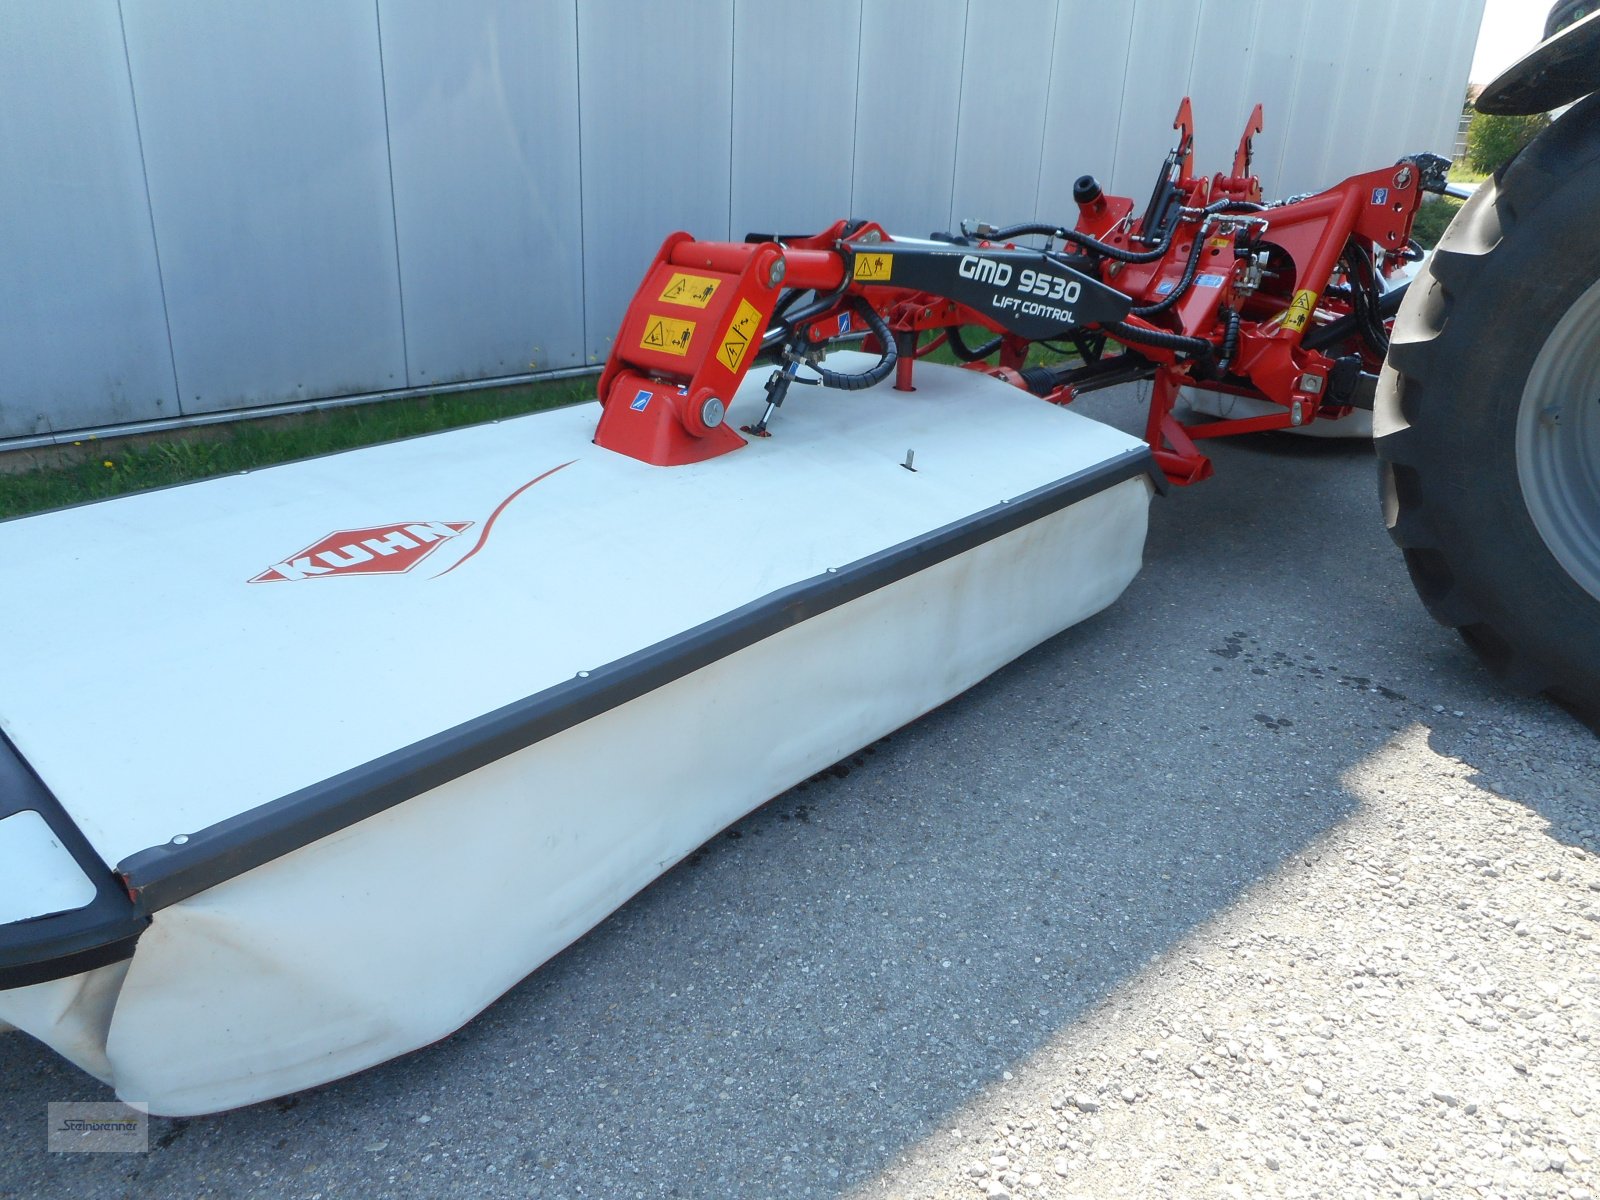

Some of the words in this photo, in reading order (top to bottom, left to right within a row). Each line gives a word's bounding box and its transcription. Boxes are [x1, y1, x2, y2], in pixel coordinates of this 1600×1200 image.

[959, 255, 1012, 287] GMD
[1018, 269, 1081, 304] 9530
[992, 294, 1022, 311] LIFT
[1021, 301, 1075, 324] CONTROL
[269, 521, 462, 581] KUHN
